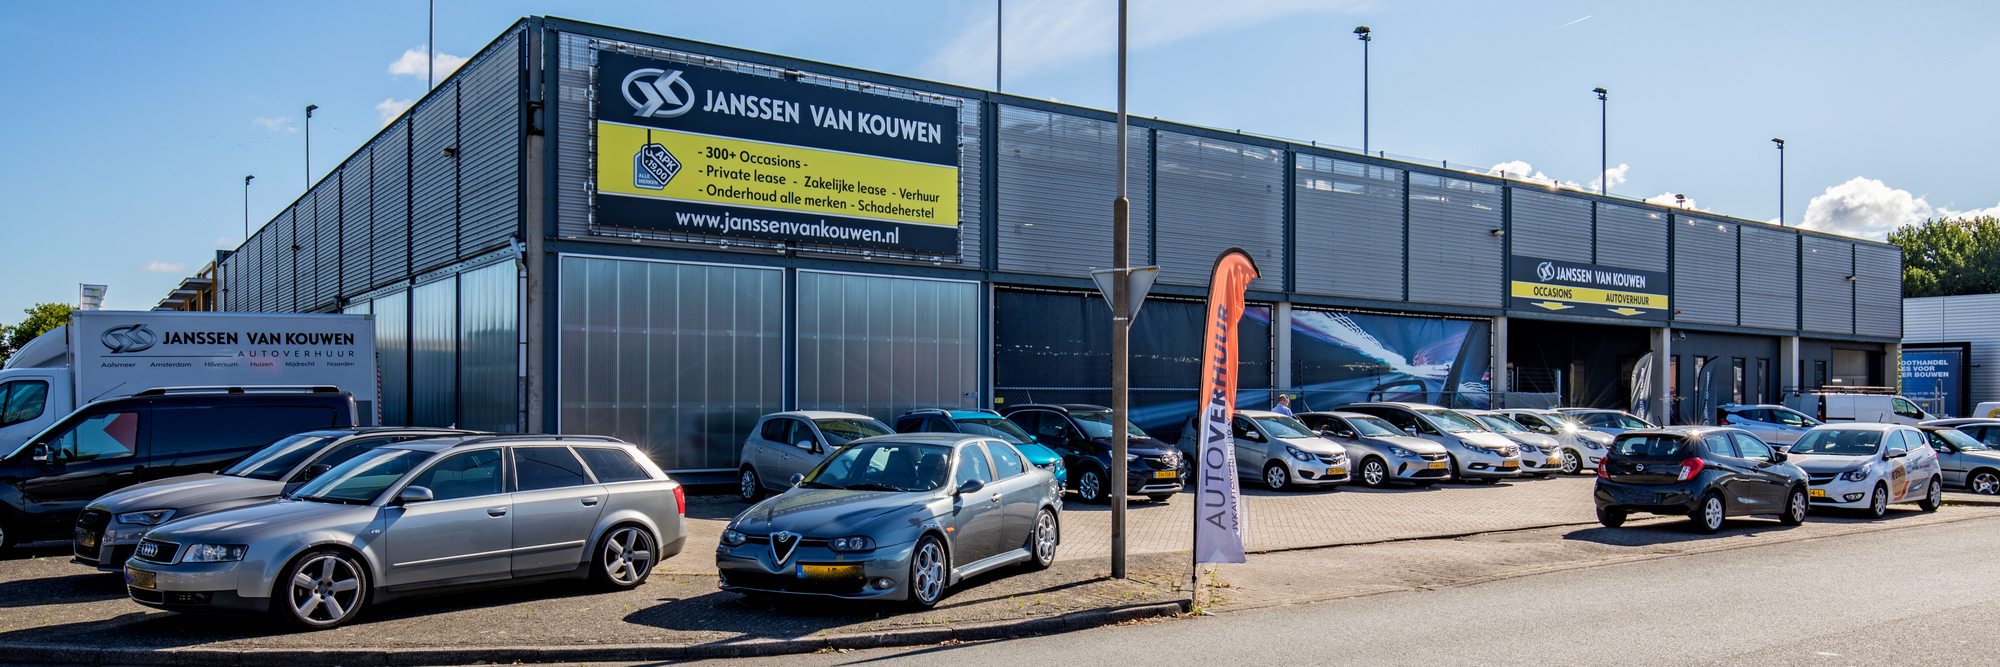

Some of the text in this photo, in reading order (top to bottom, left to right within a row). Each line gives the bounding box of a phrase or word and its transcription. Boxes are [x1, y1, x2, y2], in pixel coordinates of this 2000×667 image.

[703, 89, 941, 145] JANSSEN VAN KOUWEN
[655, 150, 677, 171] APK
[706, 146, 736, 160] 300+
[740, 150, 801, 169] Occasions
[645, 159, 668, 180] €19,00
[706, 165, 751, 182] Private
[754, 169, 787, 185] lease
[804, 175, 855, 194] Zakelijke
[857, 181, 887, 196] lease
[899, 187, 940, 203] Verhuur
[706, 184, 777, 202] Onderhoud
[780, 191, 802, 205] alle
[804, 195, 847, 209] merken
[858, 199, 934, 218] Schadeherstel
[675, 211, 899, 244] www.janssenvankouwen.nl
[1556, 266, 1646, 289] JANSSEN VAN KOUWEN
[1533, 286, 1573, 299] OCCASIONS
[1605, 293, 1650, 306] AUTOVERHUUR
[162, 331, 355, 346] JANSSEN VAN KOUWEN
[1205, 303, 1228, 531] AUTOVERHUUR
